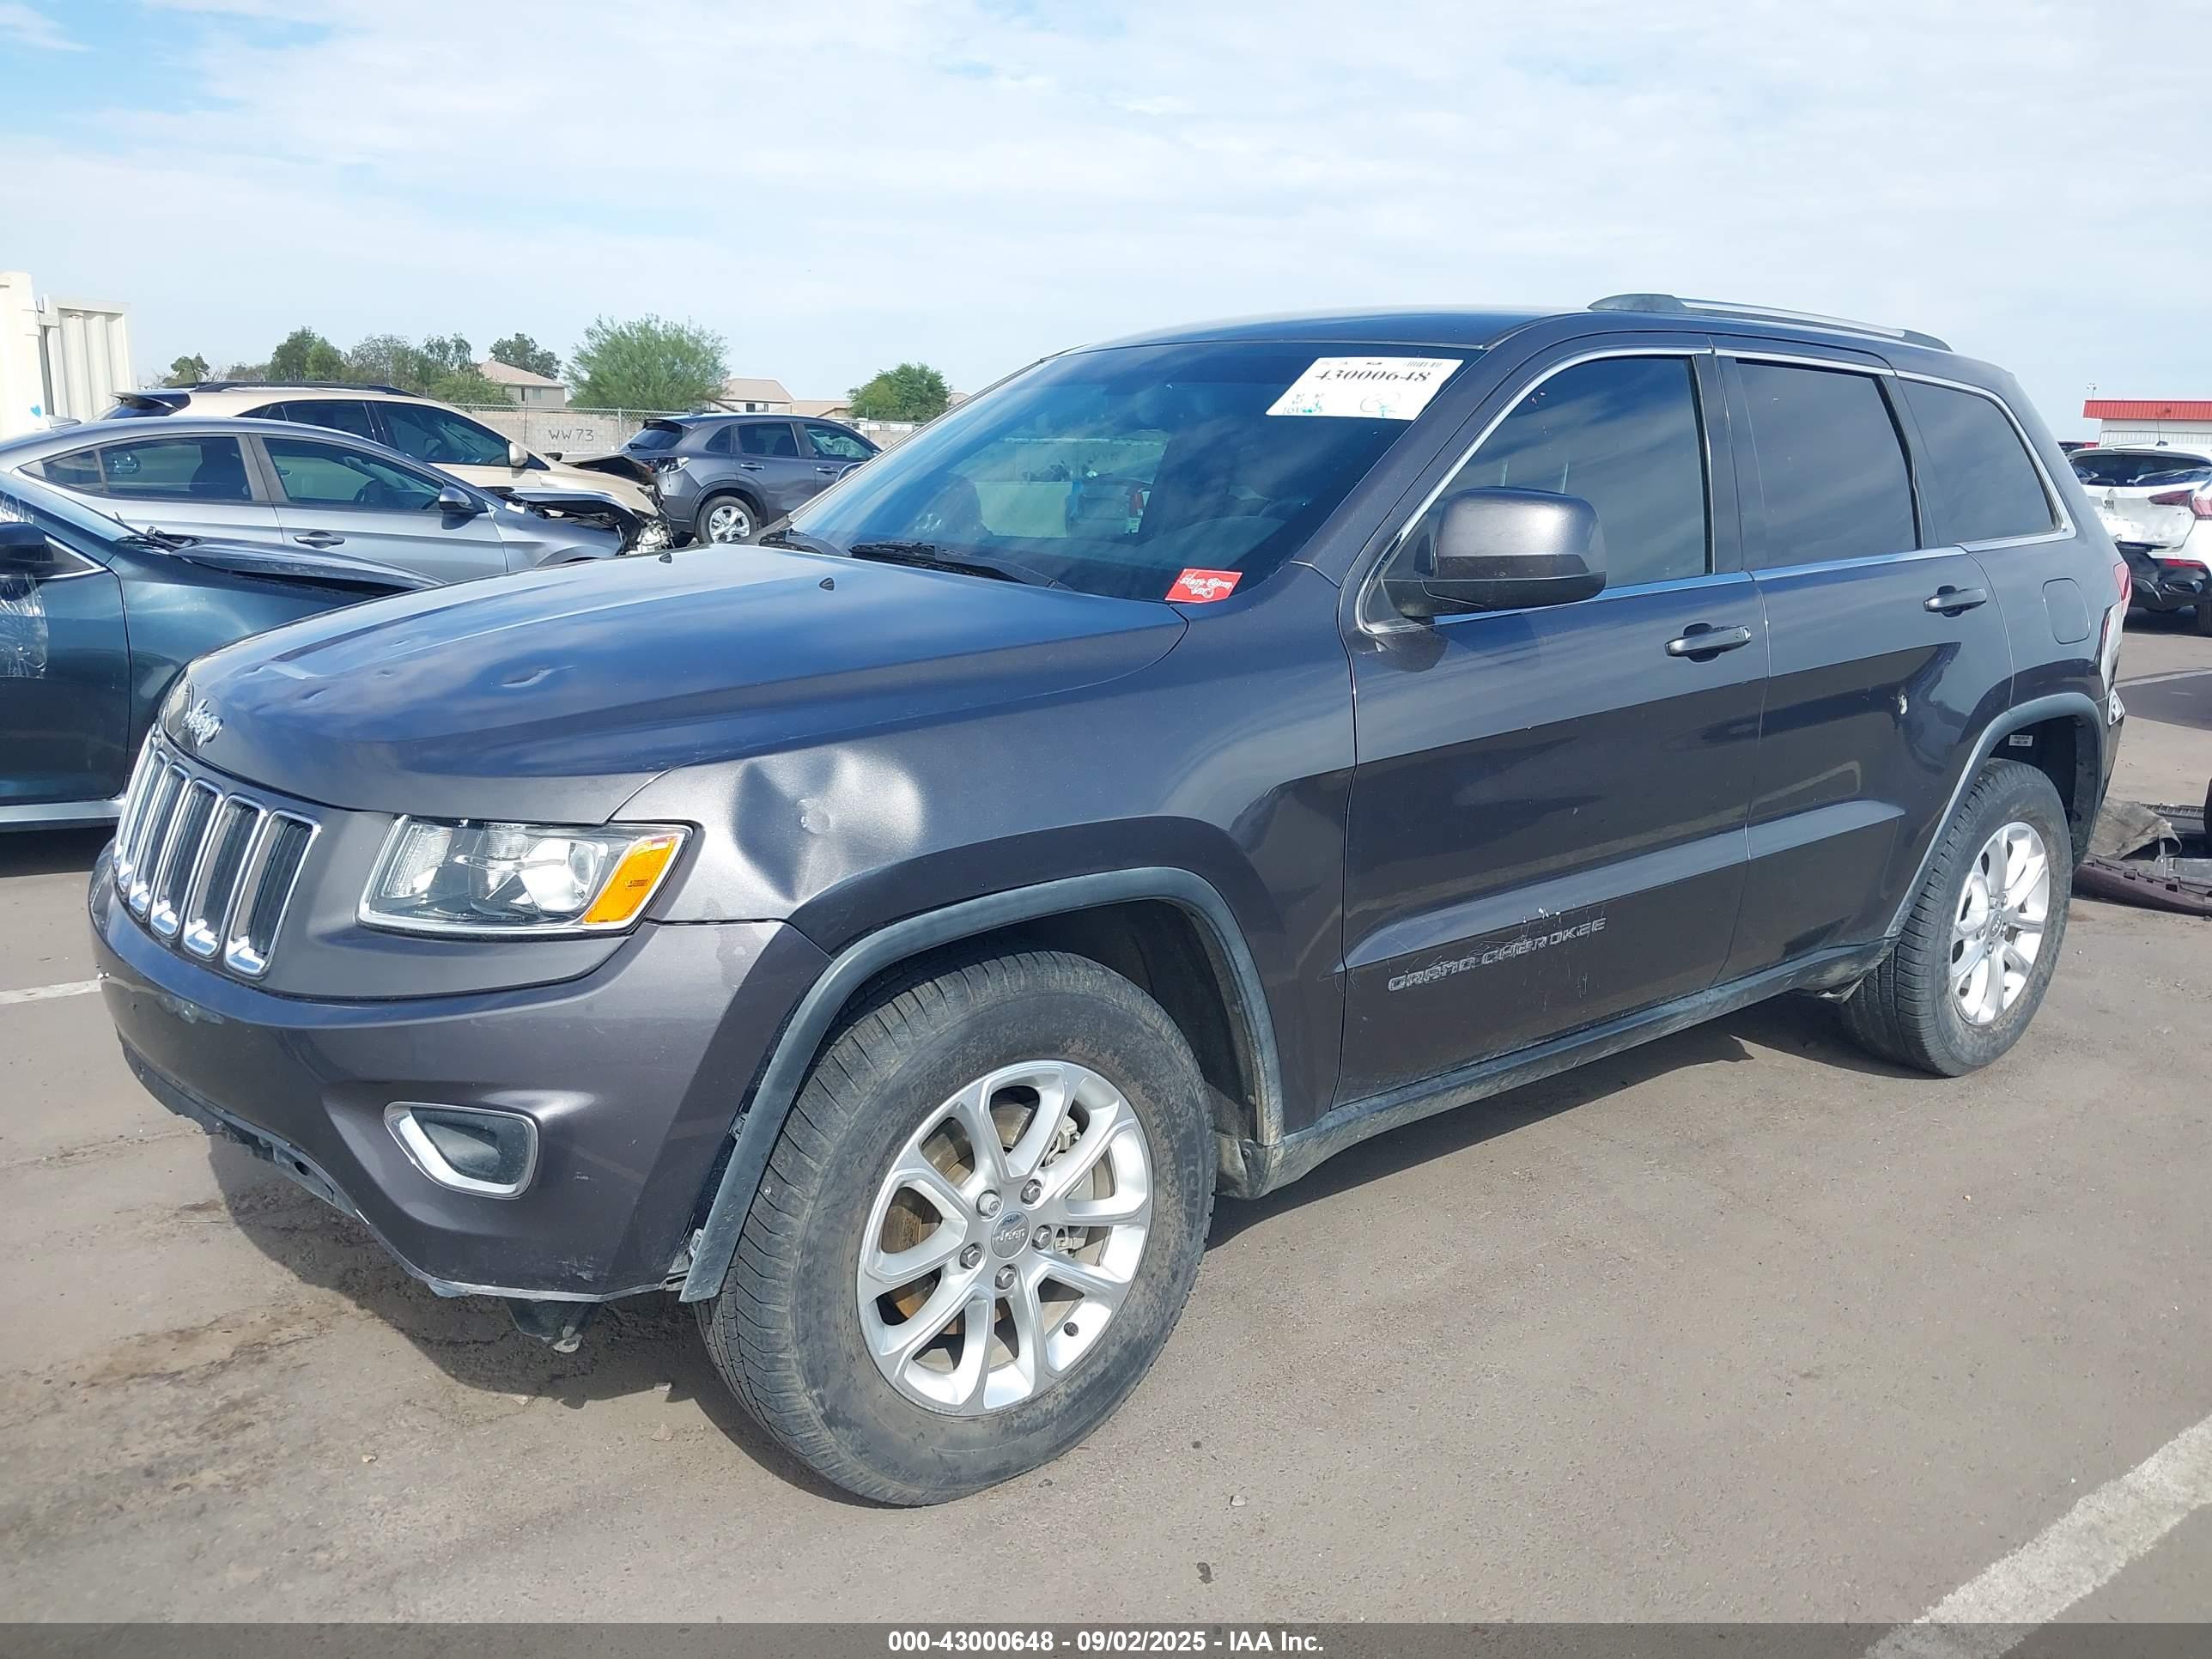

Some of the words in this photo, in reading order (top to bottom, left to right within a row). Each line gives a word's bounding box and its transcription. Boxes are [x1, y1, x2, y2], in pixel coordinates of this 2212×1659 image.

[1316, 368, 1431, 382] 43000648
[1388, 955, 1476, 992] GRAND
[1481, 917, 1607, 965] CHEROKEE
[996, 1228, 1026, 1243] Jeep
